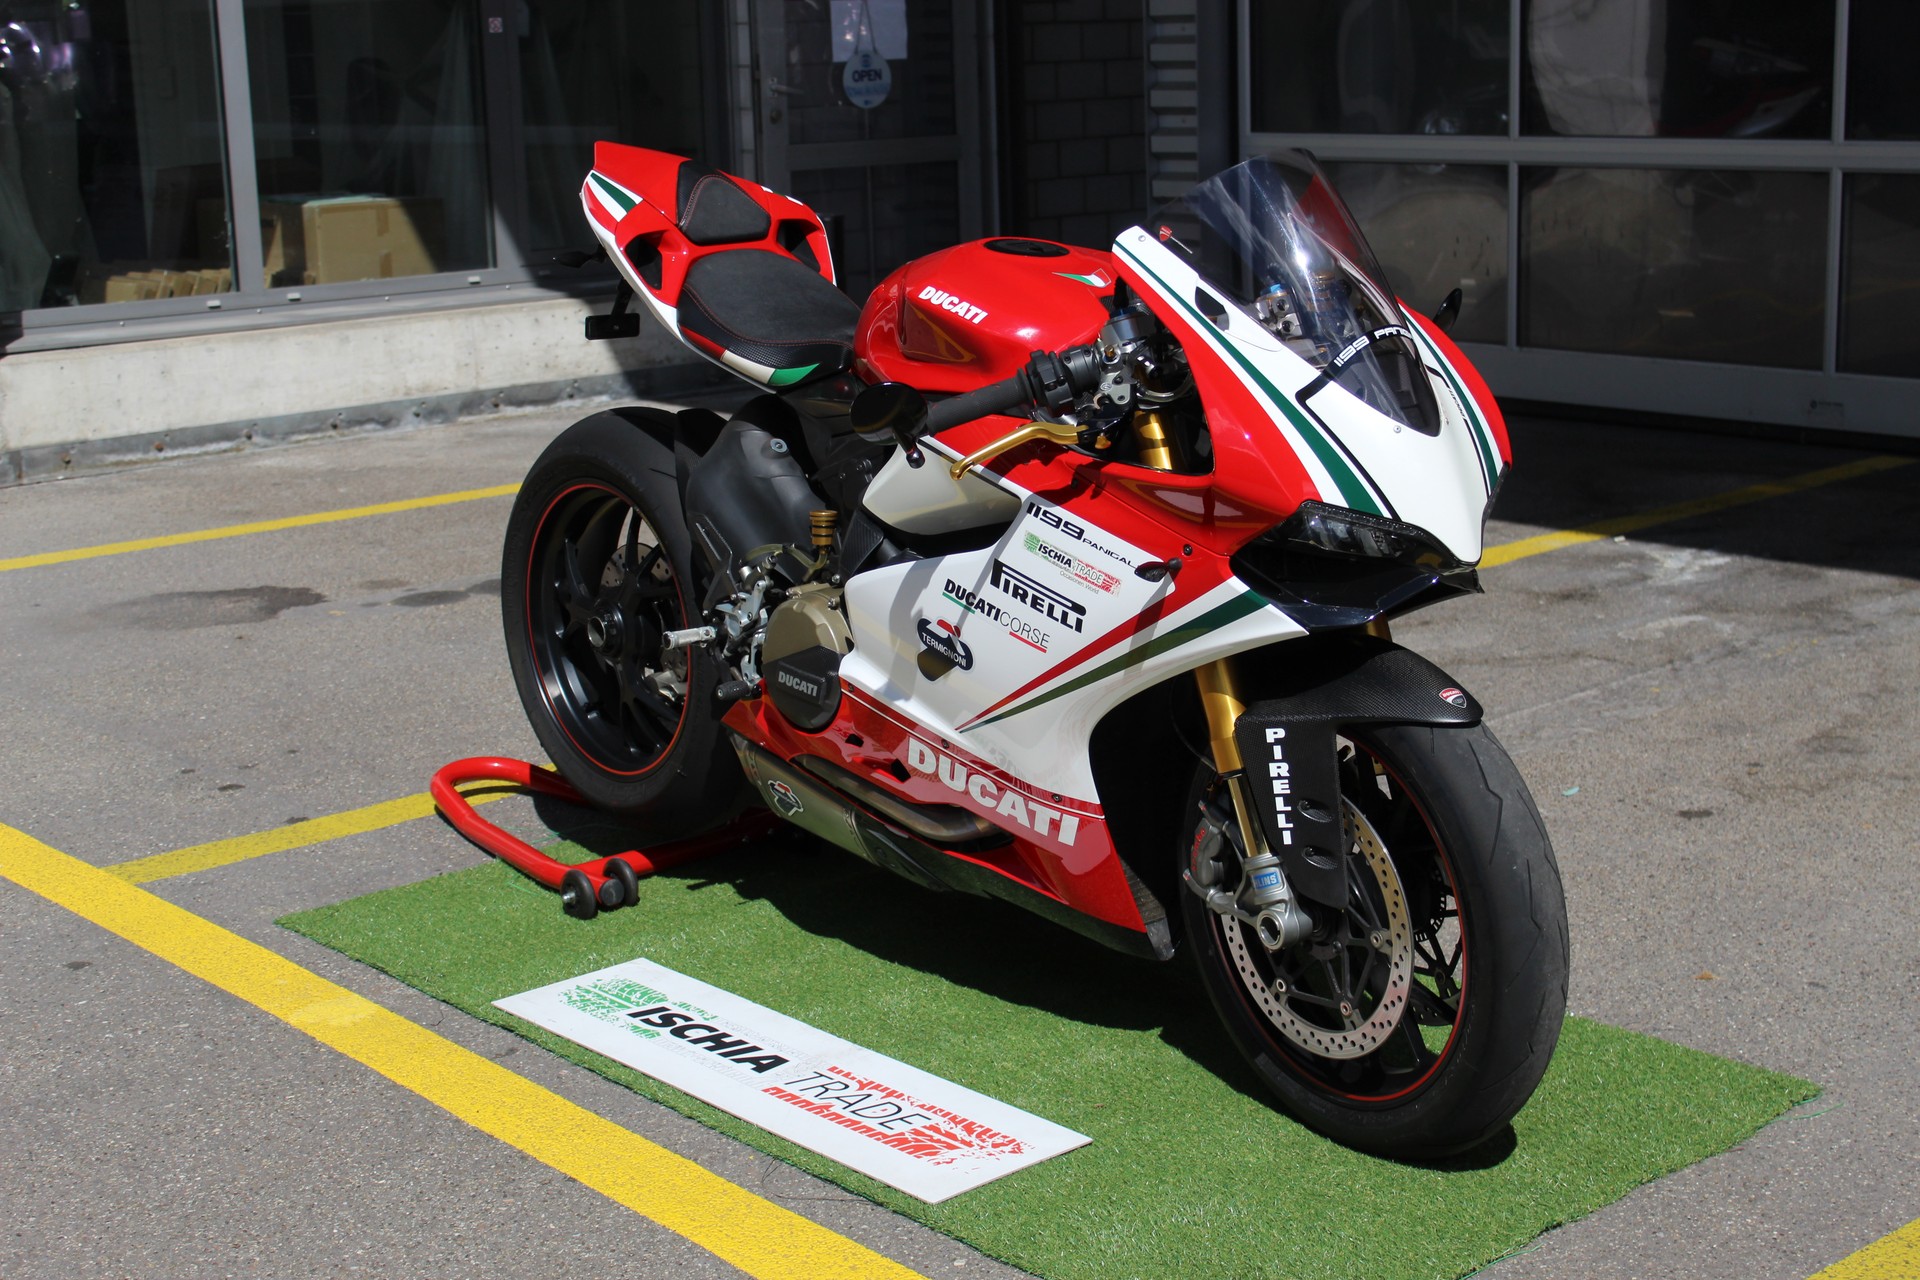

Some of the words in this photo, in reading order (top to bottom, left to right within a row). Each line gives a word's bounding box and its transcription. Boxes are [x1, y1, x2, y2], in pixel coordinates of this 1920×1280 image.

[852, 69, 882, 83] OPEN
[918, 285, 989, 325] DUCATI
[1333, 335, 1370, 367] 1199
[1026, 501, 1085, 541] 1199
[1082, 537, 1138, 569] PANIGAL
[1038, 543, 1073, 568] ISCHIA
[1075, 563, 1104, 584] TRADE
[990, 558, 1087, 634] PIRELLI
[1085, 582, 1100, 595] World
[921, 631, 967, 668] TERMIGNONI
[777, 670, 818, 698] DUCATI
[907, 736, 1080, 847] DUCATI
[1265, 727, 1294, 846] PIRELLI
[627, 1006, 790, 1074] ISCHIA
[784, 1071, 934, 1130] TRADE
